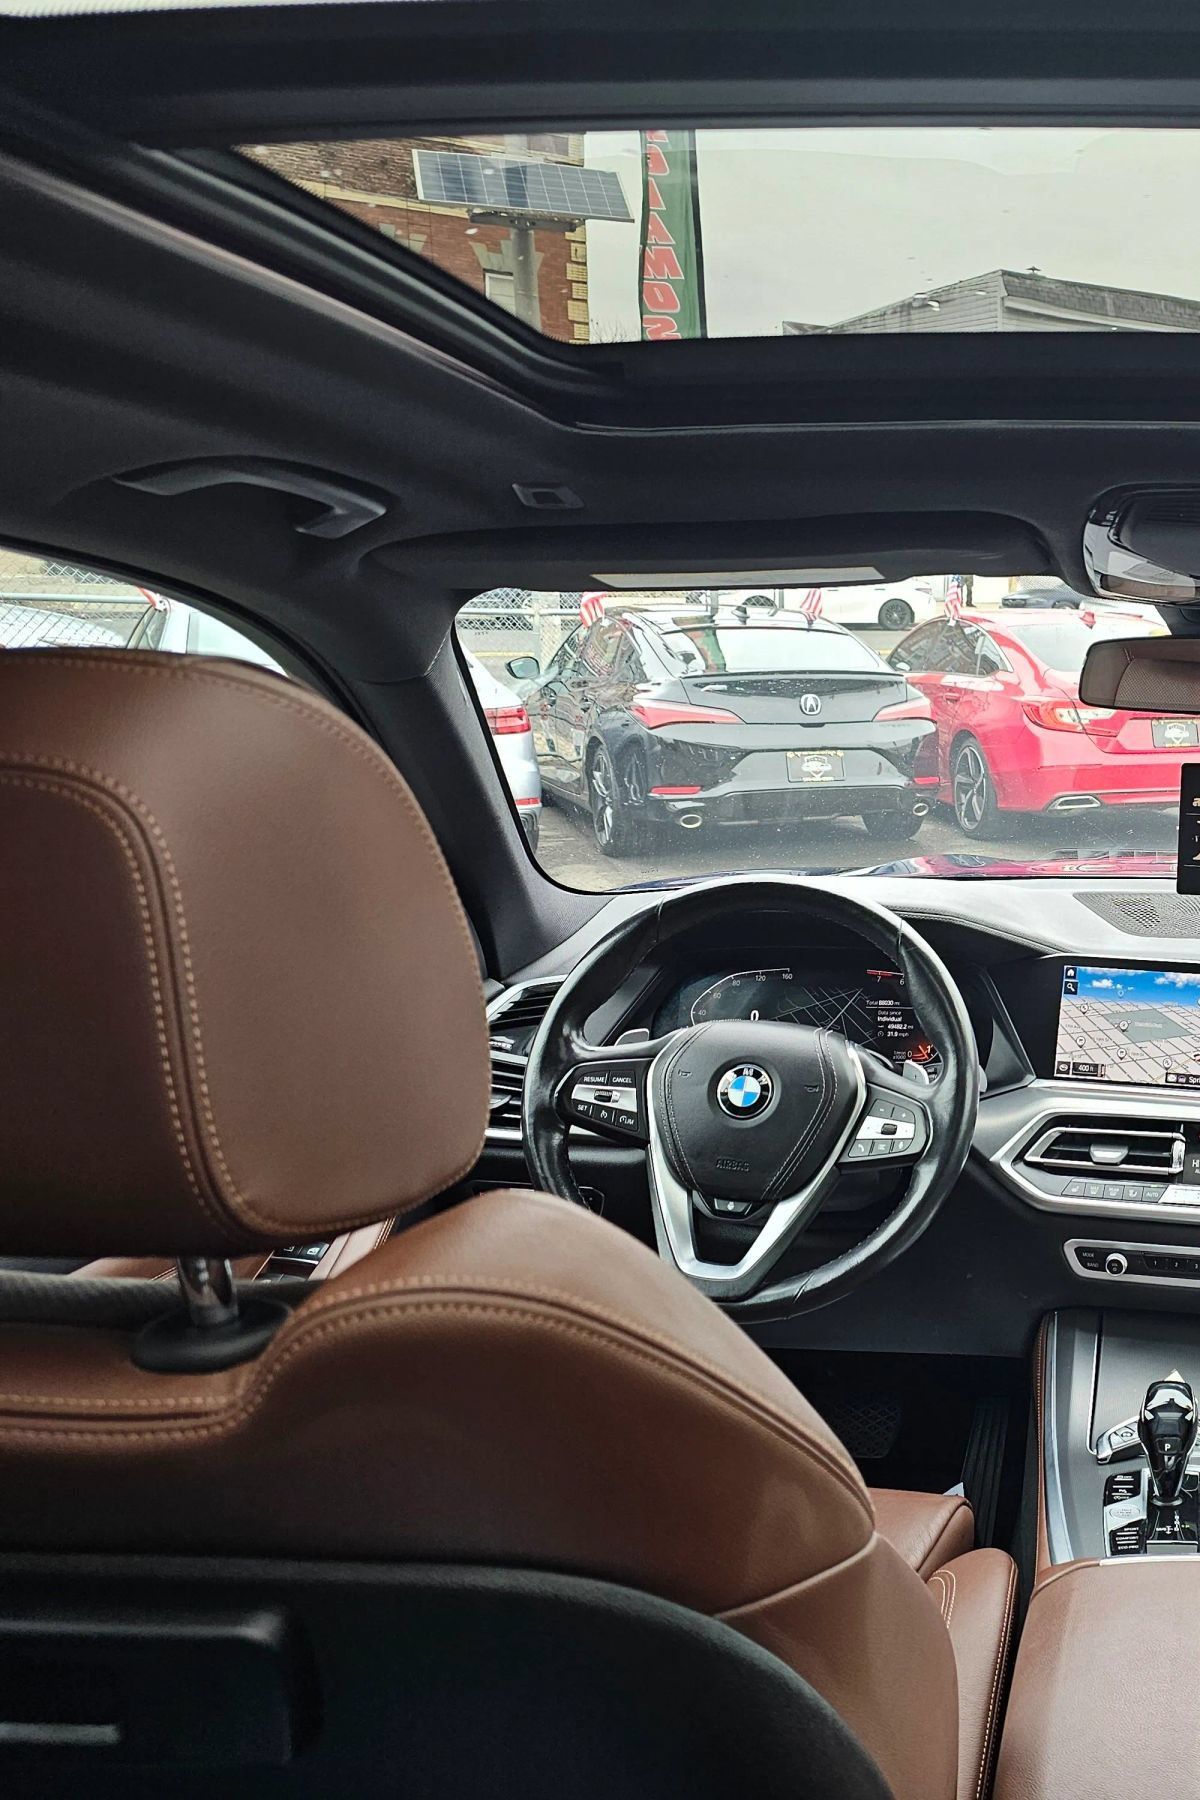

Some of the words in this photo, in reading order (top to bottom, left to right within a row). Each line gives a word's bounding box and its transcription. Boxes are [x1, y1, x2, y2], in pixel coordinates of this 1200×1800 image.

[1078, 1064, 1090, 1072] 400
[612, 1076, 633, 1084] CANCEL
[1192, 1159, 1200, 1168] HI
[1165, 1443, 1171, 1452] P
